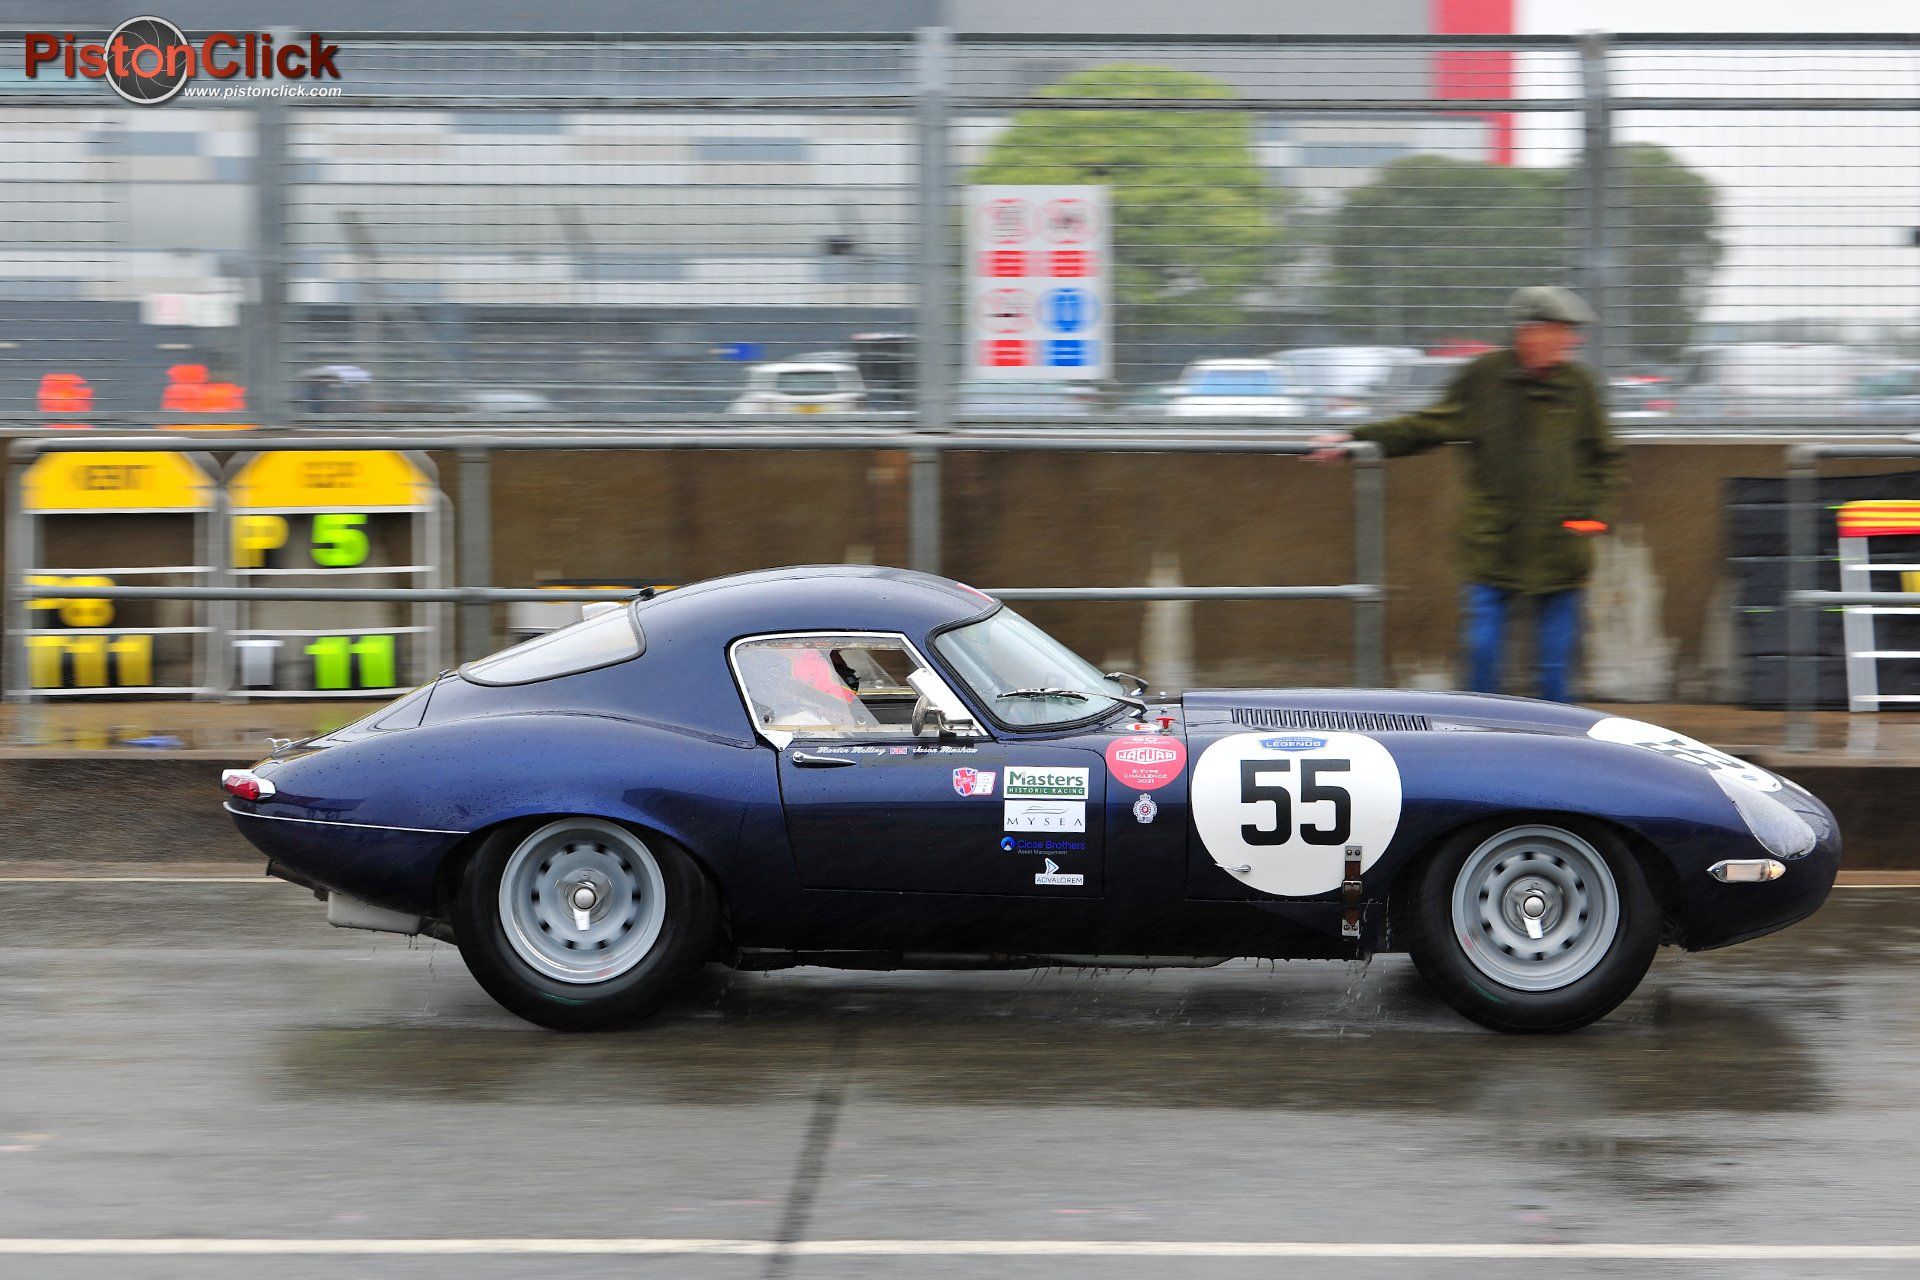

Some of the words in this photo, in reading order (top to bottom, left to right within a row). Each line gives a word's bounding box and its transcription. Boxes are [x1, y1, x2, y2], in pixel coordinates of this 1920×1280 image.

[310, 514, 370, 567] 5
[1119, 749, 1174, 763] JAGUAR
[1009, 771, 1084, 787] Masters
[1240, 759, 1351, 846] 55
[1017, 840, 1043, 849] Close
[1046, 840, 1086, 850] Brothers
